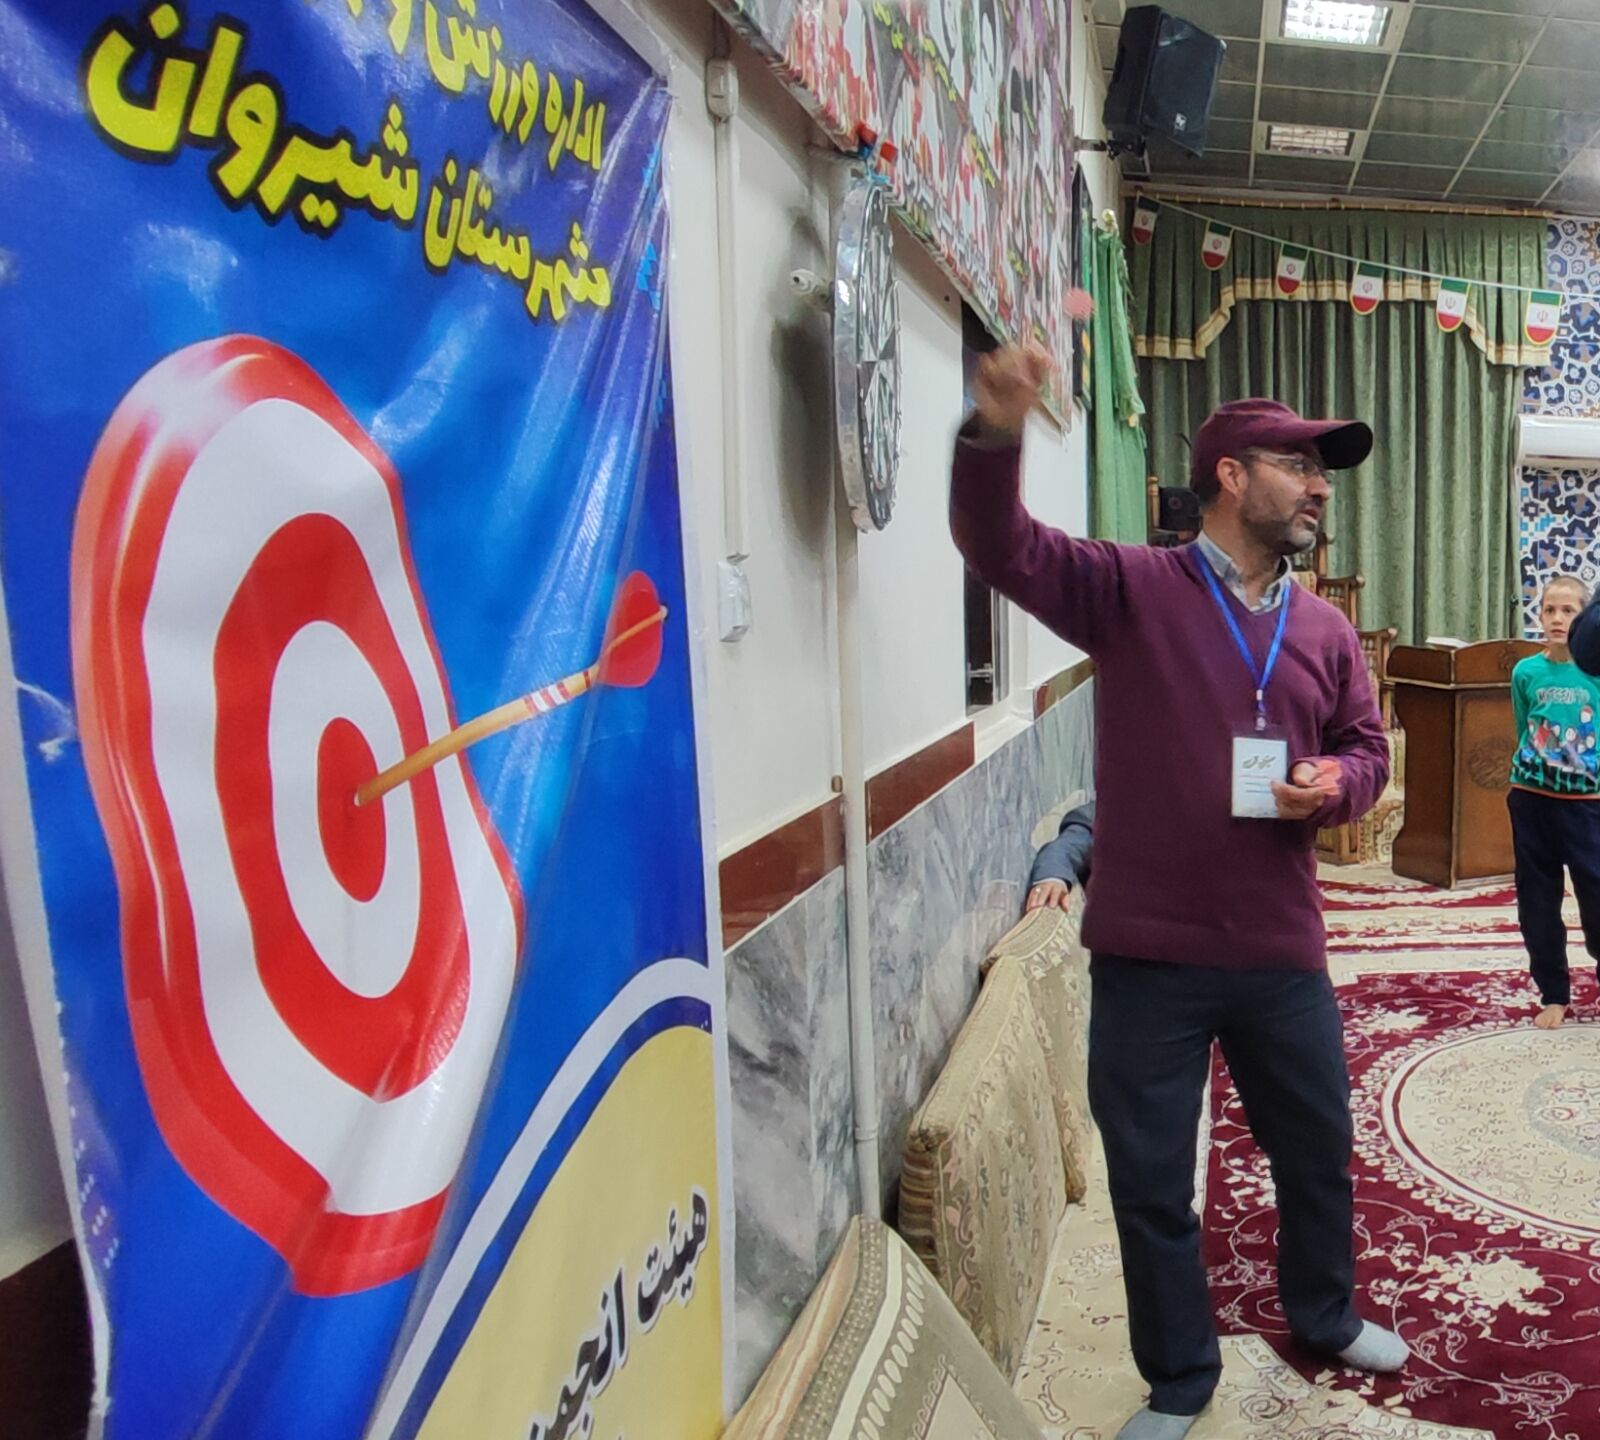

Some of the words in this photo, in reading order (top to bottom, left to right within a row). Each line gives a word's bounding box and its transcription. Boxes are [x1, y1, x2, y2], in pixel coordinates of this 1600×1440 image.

[86, 2, 420, 231] شیروان
[424, 0, 541, 145] ورزش
[547, 71, 606, 171] اداره
[423, 158, 612, 321] شهرستان
